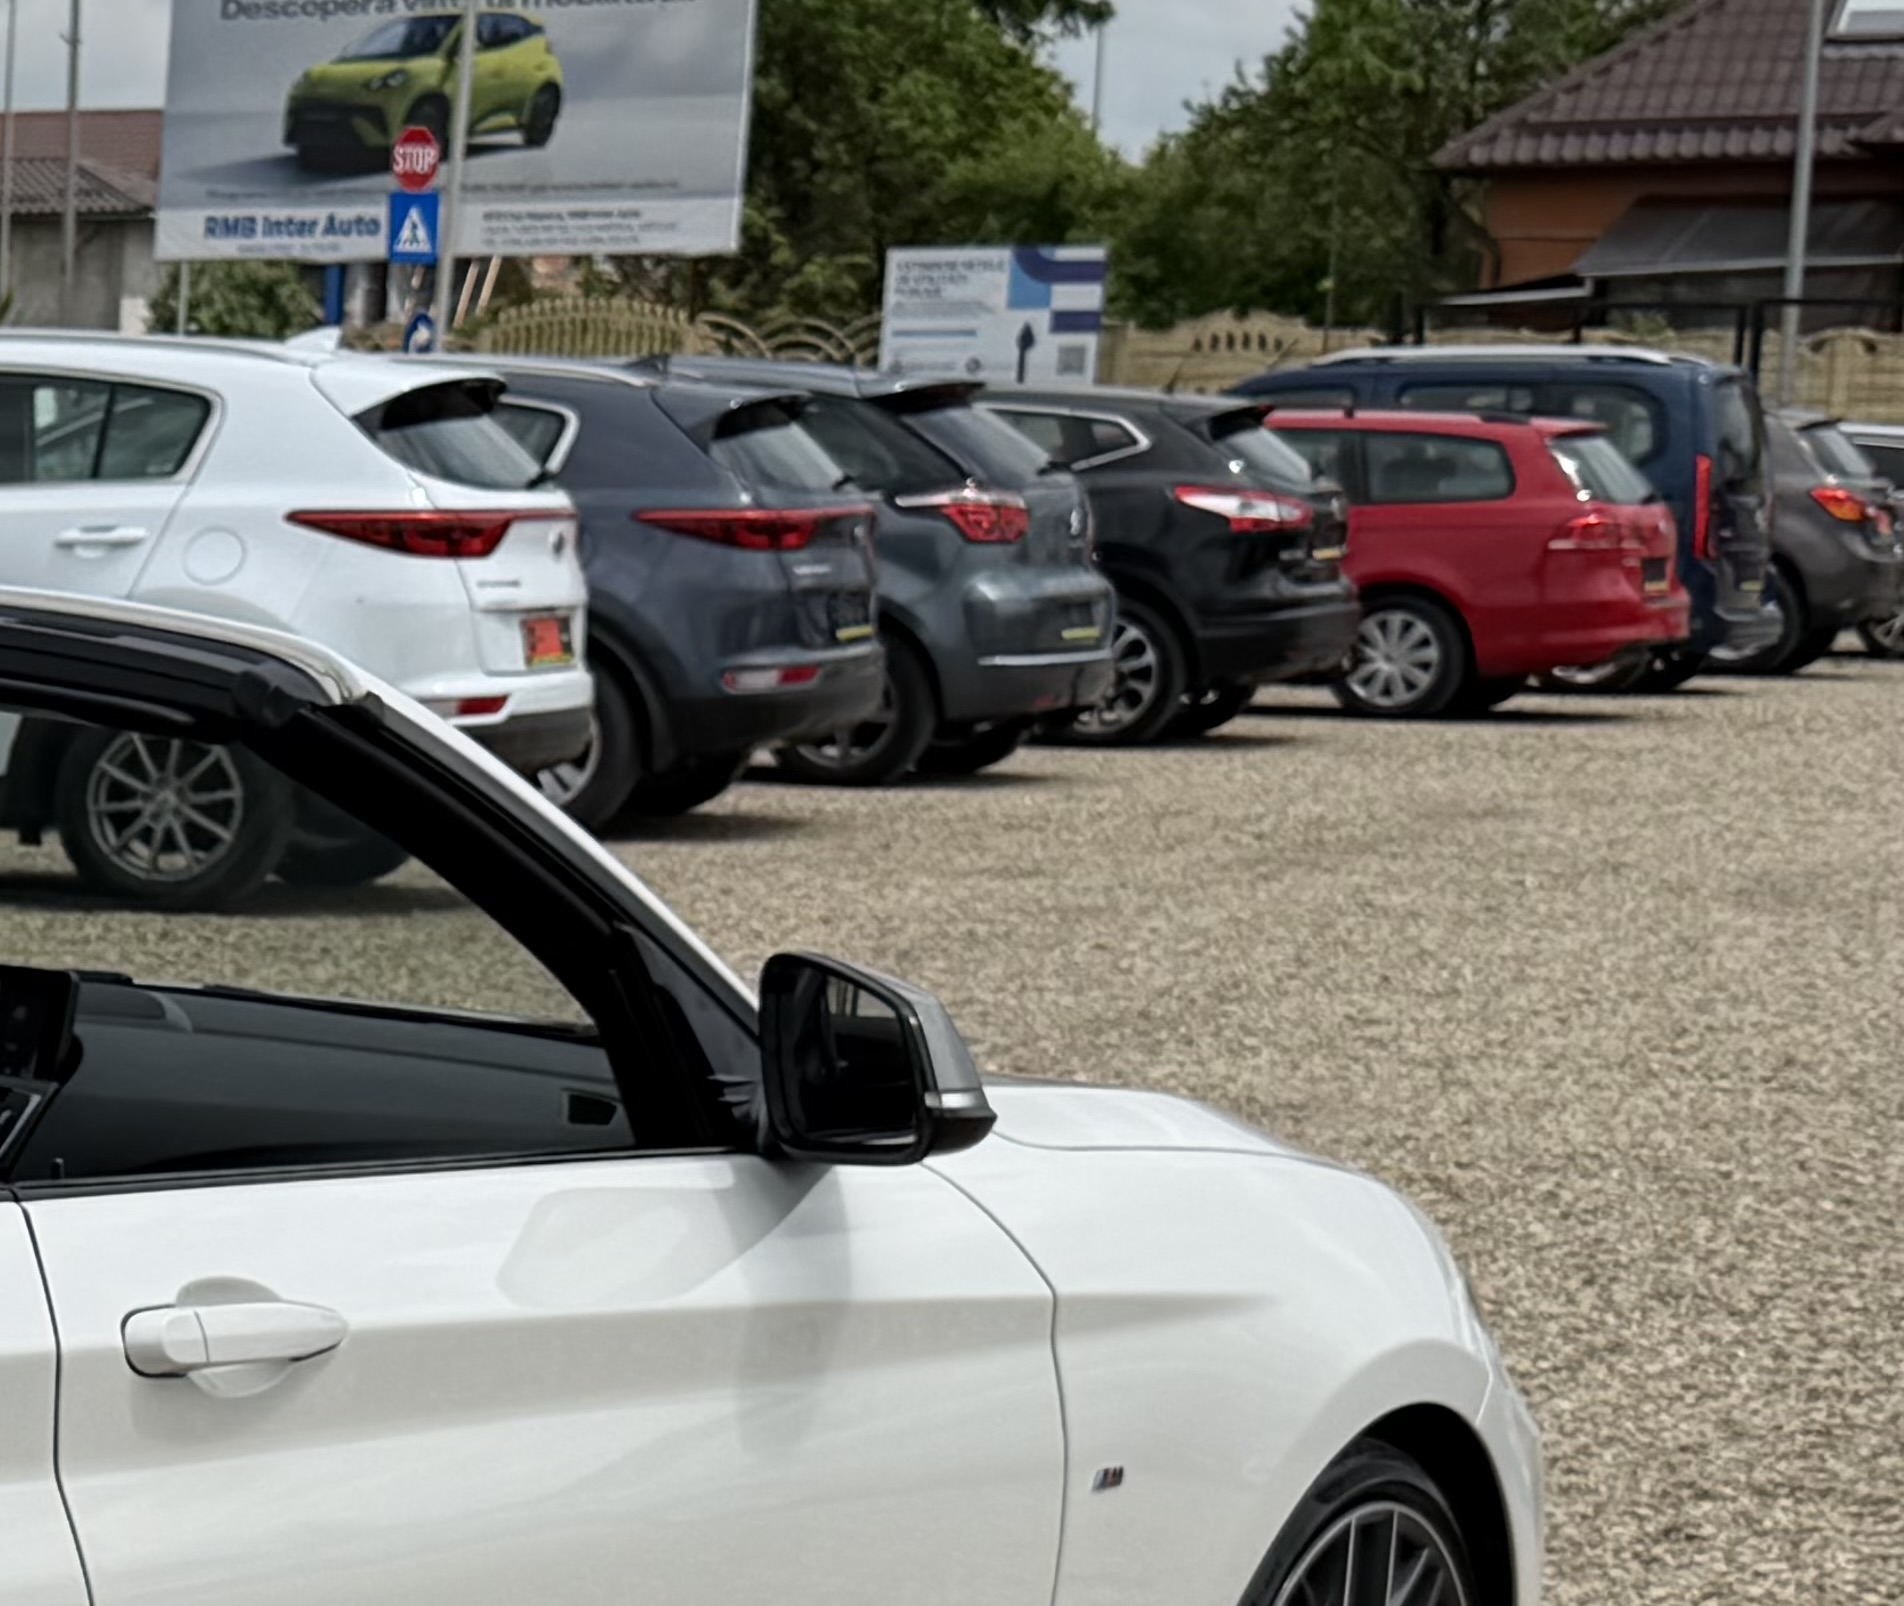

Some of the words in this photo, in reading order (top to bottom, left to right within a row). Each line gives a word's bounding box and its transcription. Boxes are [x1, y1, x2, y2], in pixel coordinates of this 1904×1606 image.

[393, 144, 439, 175] STOP
[204, 216, 257, 239] RMB
[262, 215, 320, 239] Inter
[321, 213, 381, 238] Auto
